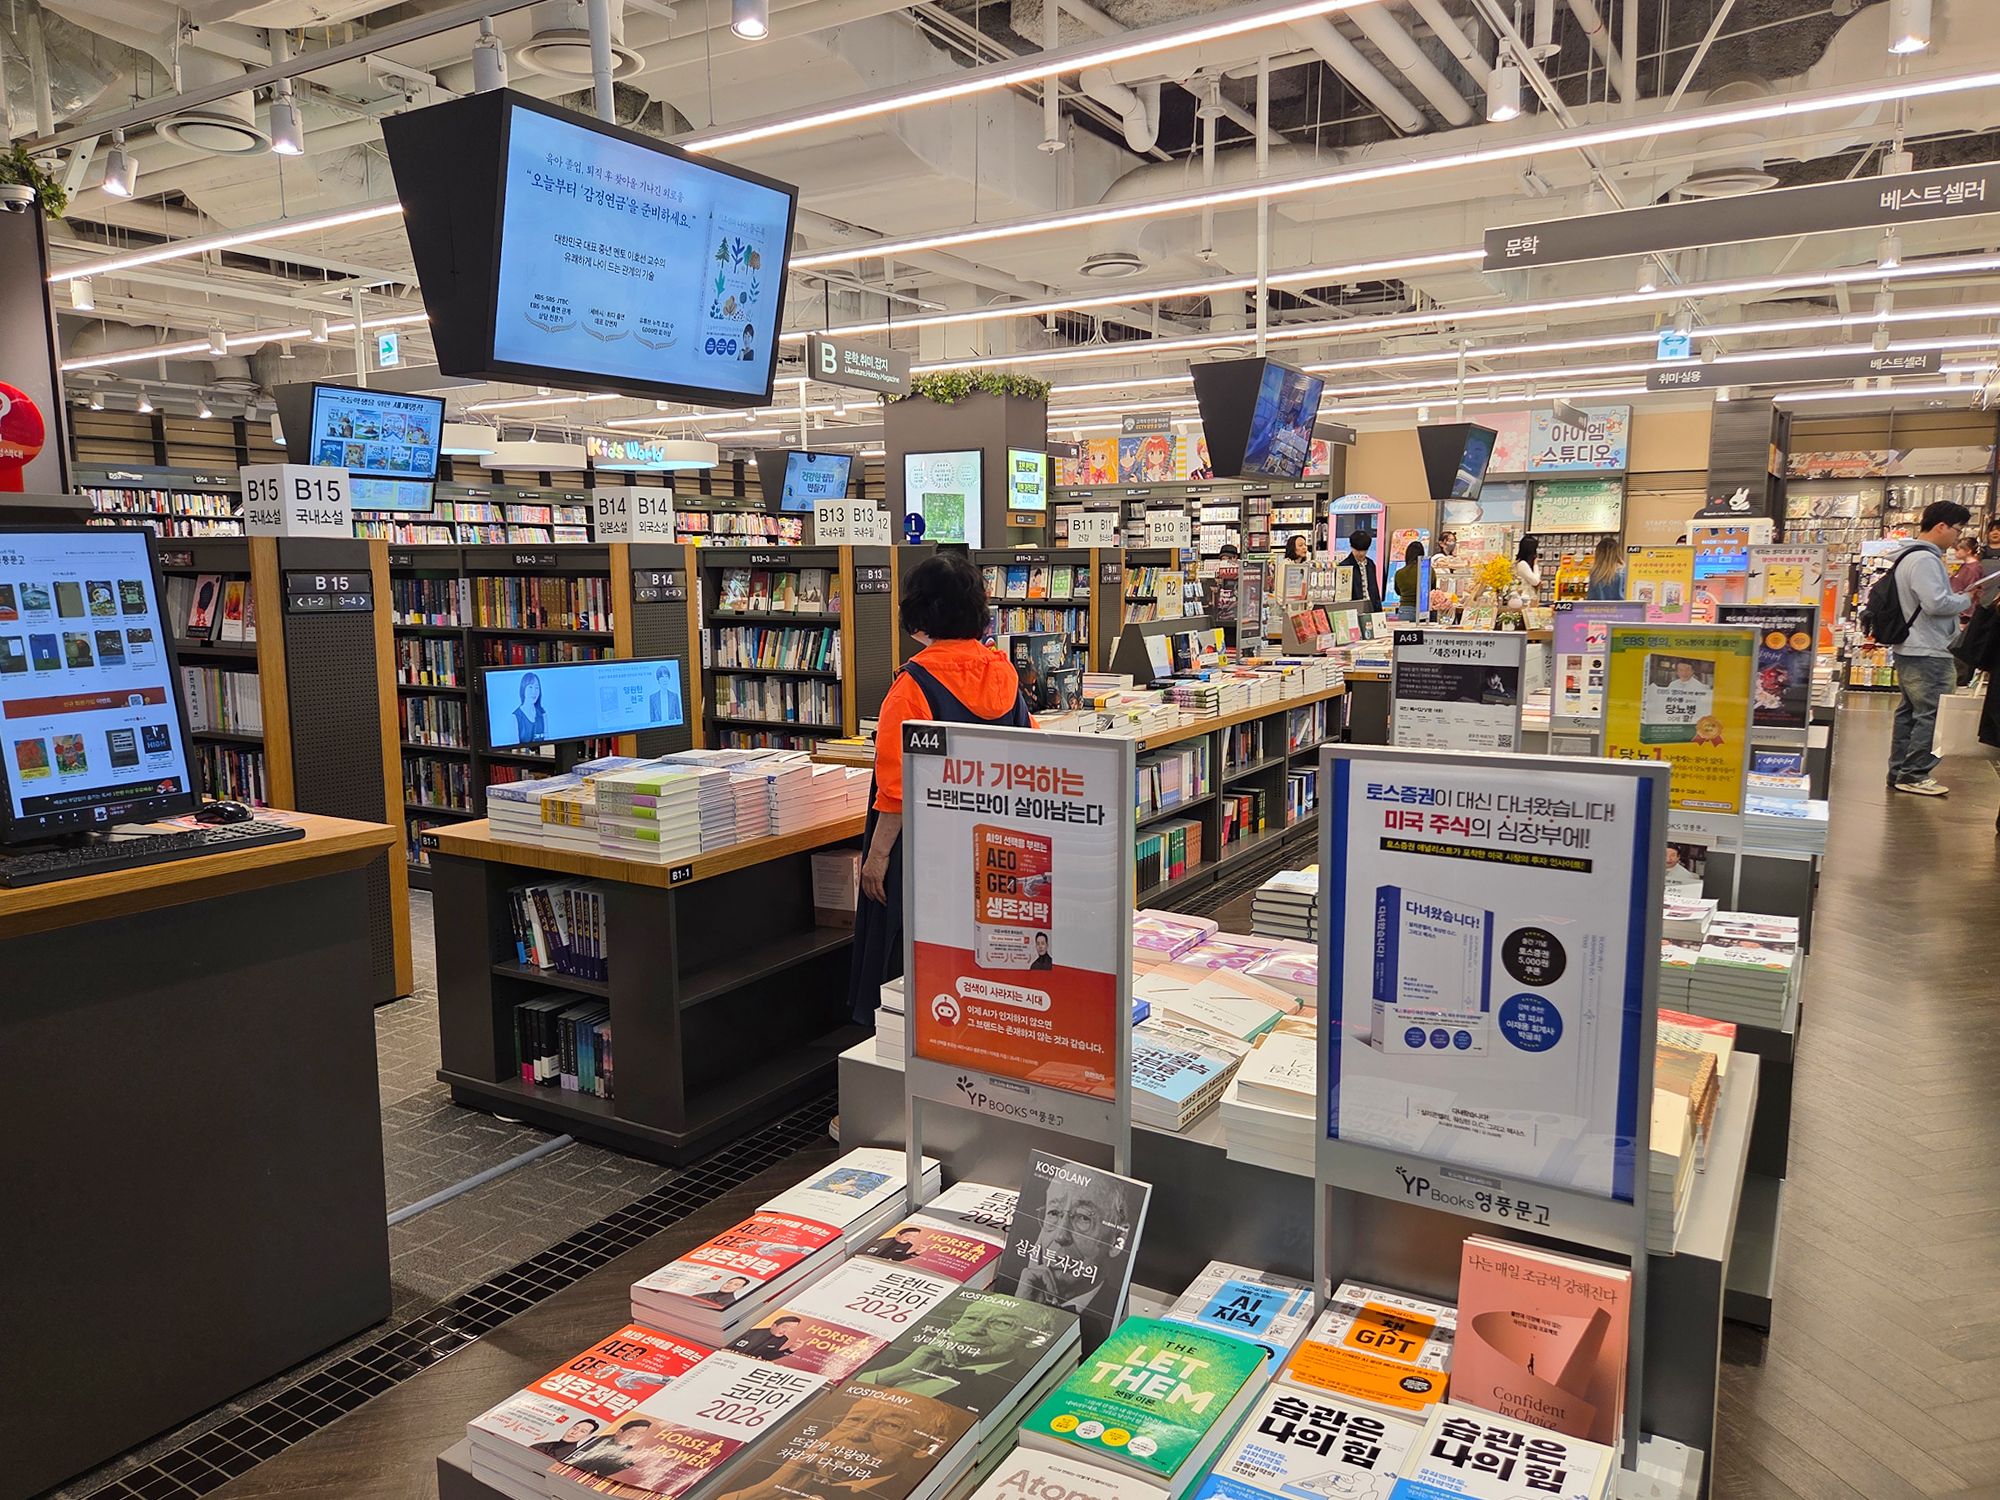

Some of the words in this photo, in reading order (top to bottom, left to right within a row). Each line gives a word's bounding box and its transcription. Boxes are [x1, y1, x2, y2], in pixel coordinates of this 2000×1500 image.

[546, 152, 563, 168] 육아
[586, 165, 603, 181] 퇴직
[604, 169, 613, 182] 후
[615, 173, 637, 190] 찾아올
[639, 181, 661, 197] 기나긴
[663, 188, 685, 203] 외로움
[1880, 178, 1986, 209] 베스트셀러
[554, 233, 583, 249] 대한민국
[583, 240, 597, 253] 대표
[1505, 234, 1539, 257] 문학
[564, 252, 592, 267] 유쾌하게
[593, 259, 607, 270] 나이
[608, 263, 621, 274] 드는
[821, 342, 838, 374] B
[1870, 355, 1927, 370] 베스트셀러
[587, 437, 625, 459] Kids
[625, 442, 665, 462] World
[1542, 444, 1612, 463] 스튜디오
[247, 479, 279, 502] B15
[295, 477, 341, 502] B15
[807, 483, 827, 493] 만들기
[249, 509, 282, 525] 국내소설
[295, 508, 344, 525] 국내소설
[599, 497, 626, 516] B14
[638, 497, 668, 516] B14
[819, 507, 845, 522] B13
[853, 507, 874, 523] B13
[599, 520, 628, 534] 일본소설
[638, 521, 668, 534] 외국소설
[819, 527, 845, 538] 국내수필
[853, 527, 874, 538] 국내수필
[1073, 519, 1093, 530] B11
[1154, 522, 1175, 533] B10
[1078, 534, 1090, 543] 건강
[516, 554, 536, 565] B14-3
[752, 555, 770, 563] B13-3
[1166, 581, 1176, 596] B2
[307, 597, 324, 606] 1-2
[339, 596, 358, 606] 3-4
[1555, 602, 1572, 611] A42
[1400, 631, 1418, 643] A43
[1622, 636, 1645, 647] EBS
[1665, 704, 1697, 715] 당뇨병
[910, 732, 939, 749] A44
[942, 758, 985, 787] AI가
[990, 762, 1085, 797] 기억하는
[926, 787, 1009, 816] 브랜드만이
[1015, 796, 1105, 826] 살아남는다
[1366, 782, 1452, 808] 토스증권이
[1456, 790, 1492, 811] 대신
[1497, 793, 1615, 822] 다녀왔습니다!
[1384, 809, 1424, 833] 미국
[1429, 814, 1491, 838] 주식의
[1497, 818, 1591, 849] 심장부에!
[424, 836, 438, 848] B1-1
[985, 832, 1003, 845] AI의
[1003, 836, 1026, 849] 선택을
[1026, 840, 1048, 853] 부르는
[1386, 840, 1416, 850] 토스증권
[1487, 851, 1504, 860] 미국
[1505, 852, 1529, 864] 시장의
[1531, 855, 1548, 866] 투자
[986, 847, 1017, 870] AEO
[672, 868, 690, 882] B1-1
[986, 872, 1018, 895] GEO
[986, 896, 1049, 924] 생존전략
[1405, 900, 1480, 929] 다녀왔습니다!
[1376, 905, 1386, 958] 다녀왔습니다!
[1518, 947, 1550, 959] 토스증권
[1518, 956, 1550, 968] 5,000원
[1525, 965, 1541, 976] 쿠폰
[963, 981, 988, 996] 검색이
[990, 986, 1023, 1003] 사라지는
[1025, 993, 1043, 1006] 시대
[967, 1005, 982, 1016] 이제
[982, 1008, 998, 1019] AI가
[998, 1010, 1029, 1025] 인지하지
[1029, 1017, 1053, 1030] 않으면
[967, 1019, 975, 1027] 그
[976, 1020, 1004, 1034] 브랜드는
[1006, 1025, 1036, 1040] 존재하지
[1037, 1031, 1052, 1044] 않는
[1053, 1035, 1069, 1047] 것과
[1070, 1039, 1105, 1054] 같습니다.
[1531, 1024, 1555, 1036] 회계사
[967, 1091, 987, 1107] YP
[988, 1100, 1028, 1119] BOOKS
[1029, 1108, 1064, 1126] 영풍문고
[1035, 1160, 1091, 1188] KOSTOLANY
[1402, 1169, 1430, 1197] YP
[1430, 1188, 1475, 1210] Books
[1474, 1190, 1550, 1227] 영풍문고
[752, 1214, 774, 1225] AI의
[774, 1217, 802, 1229] 선택을
[801, 1223, 831, 1238] 부르는
[927, 1232, 974, 1250] HORSE
[1114, 1237, 1125, 1250] 3
[689, 1248, 780, 1276] 생존전략
[929, 1243, 980, 1264] POWER
[1014, 1238, 1041, 1263] 실전
[1043, 1247, 1099, 1285] 투자강의
[879, 1273, 944, 1298] 트렌드
[1468, 1254, 1494, 1272] 나는
[1495, 1261, 1520, 1280] 매일
[1521, 1268, 1561, 1290] 조금씩
[1563, 1278, 1618, 1305] 강해진다
[864, 1285, 931, 1310] 코리아
[959, 1290, 1020, 1309] KOSTOLANY
[1229, 1296, 1263, 1313] AI
[845, 1296, 913, 1324] 2026
[1212, 1306, 1261, 1328] 지식
[806, 1324, 857, 1346] HORSE
[921, 1324, 956, 1338] 투자는
[1382, 1319, 1406, 1335] 챗
[595, 1339, 648, 1361] AEO
[620, 1329, 643, 1343] AI의
[641, 1334, 671, 1352] 선택을
[672, 1341, 704, 1363] 부르는
[806, 1338, 861, 1361] POWER
[912, 1334, 981, 1358] 심리게임이다
[1031, 1336, 1047, 1346] 2
[1165, 1341, 1198, 1355] THE
[1355, 1330, 1416, 1355] GPT
[1124, 1345, 1210, 1380] LET
[741, 1367, 812, 1393] 트렌드
[1090, 1361, 1216, 1414] THEM
[540, 1372, 639, 1418] 생존전략
[720, 1382, 797, 1411] 코리아
[846, 1385, 913, 1406] KOSTOLANY
[1136, 1396, 1156, 1406] 이론
[1493, 1385, 1566, 1420] Confident
[696, 1400, 772, 1428] 2026
[1273, 1394, 1386, 1445] 습관은
[1499, 1402, 1514, 1419] by
[1513, 1406, 1558, 1430] Choice
[653, 1429, 709, 1451] HORSE
[803, 1425, 817, 1437] 돈,
[1442, 1415, 1568, 1467] 습관은
[792, 1435, 828, 1453] 뜨겁게
[829, 1443, 882, 1469] 사랑하고
[928, 1443, 940, 1455] 1
[1256, 1416, 1338, 1458] 나의
[1341, 1441, 1384, 1471] 힘
[652, 1444, 712, 1469] POWER
[777, 1447, 815, 1465] 차갑게
[817, 1455, 872, 1481] 다루어라
[1429, 1437, 1520, 1483] 나의
[1523, 1464, 1567, 1492] 힘
